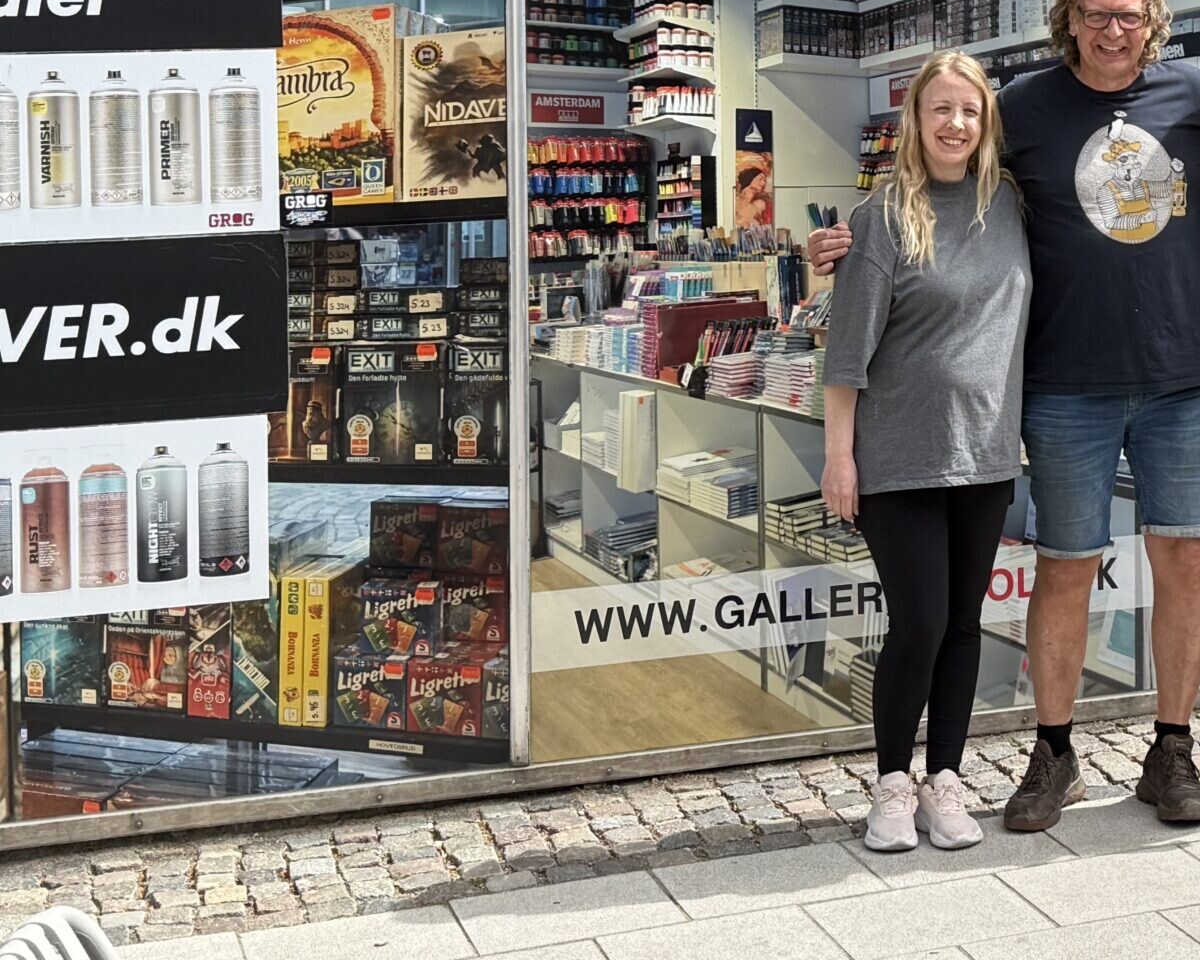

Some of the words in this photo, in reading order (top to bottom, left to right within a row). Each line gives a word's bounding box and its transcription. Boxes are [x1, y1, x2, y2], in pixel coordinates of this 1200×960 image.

[535, 96, 601, 108] AMSTERDAM
[40, 120, 51, 184] VARNISH
[161, 120, 171, 181] PRIMER
[289, 175, 312, 187] 2005
[371, 292, 399, 305] EXIT
[374, 319, 402, 331] EXIT
[351, 353, 393, 370] EXIT
[457, 352, 500, 370] EXIT
[349, 374, 361, 382] Den
[362, 374, 389, 382] forladte
[373, 508, 418, 533] Ligret
[29, 524, 39, 565] RUST
[338, 665, 386, 691] Ligret
